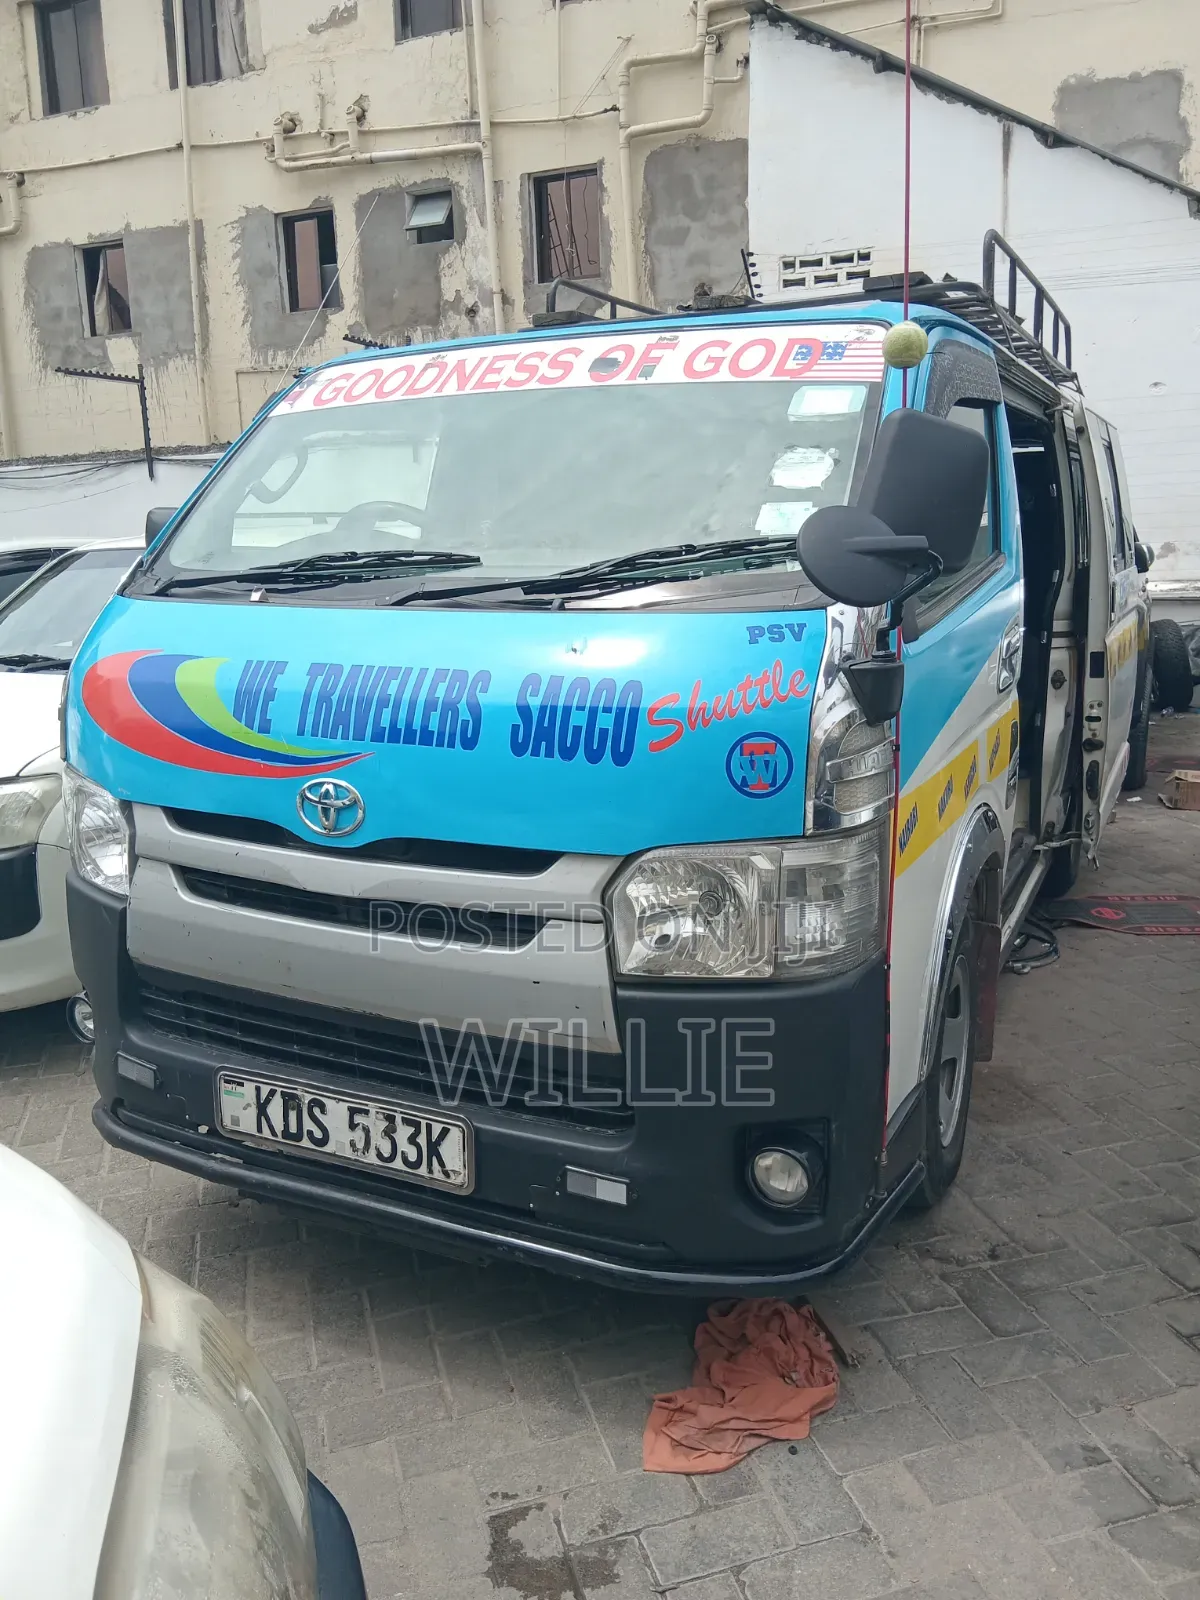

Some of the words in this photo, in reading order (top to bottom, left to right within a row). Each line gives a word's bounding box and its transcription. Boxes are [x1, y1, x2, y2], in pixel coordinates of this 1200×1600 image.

[313, 347, 582, 406] GOODNESS
[588, 340, 680, 384] OF
[682, 336, 824, 380] GOD
[746, 622, 808, 645] PSV
[233, 660, 288, 736] WE
[297, 662, 490, 751] TRAVELLERS
[510, 673, 643, 768] SACCO
[647, 659, 810, 752] Shuttle
[254, 1084, 330, 1148] KDS
[346, 1105, 452, 1179] 533K
